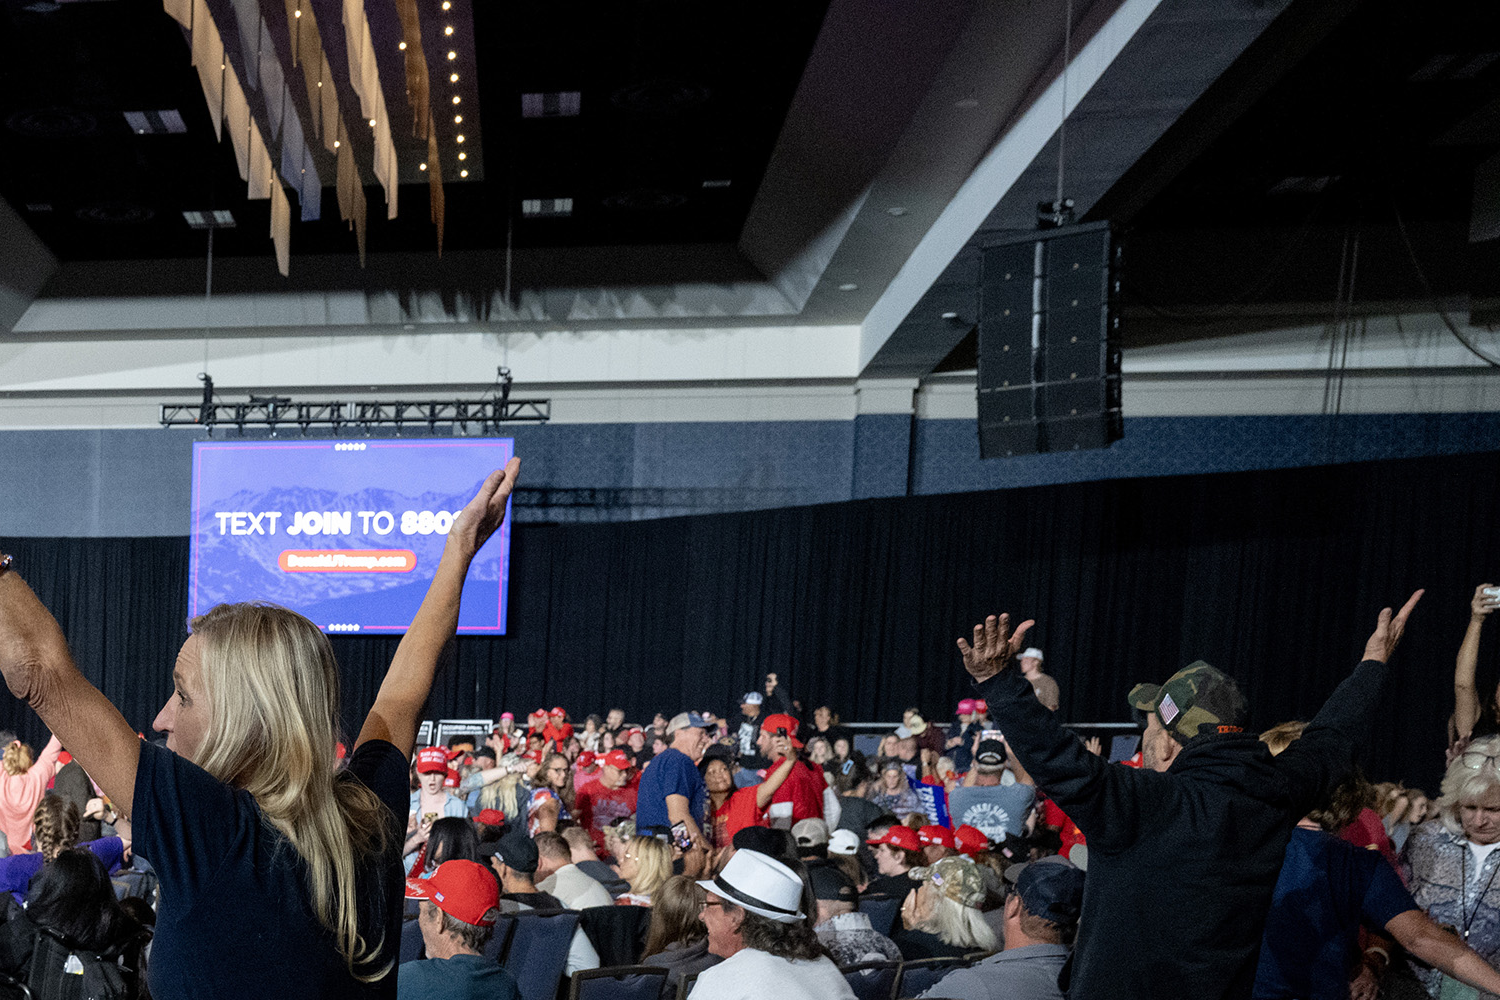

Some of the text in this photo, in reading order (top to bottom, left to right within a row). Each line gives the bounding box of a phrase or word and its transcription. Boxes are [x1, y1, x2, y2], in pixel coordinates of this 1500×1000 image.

[215, 510, 461, 536] TEXT JOIN TO 880
